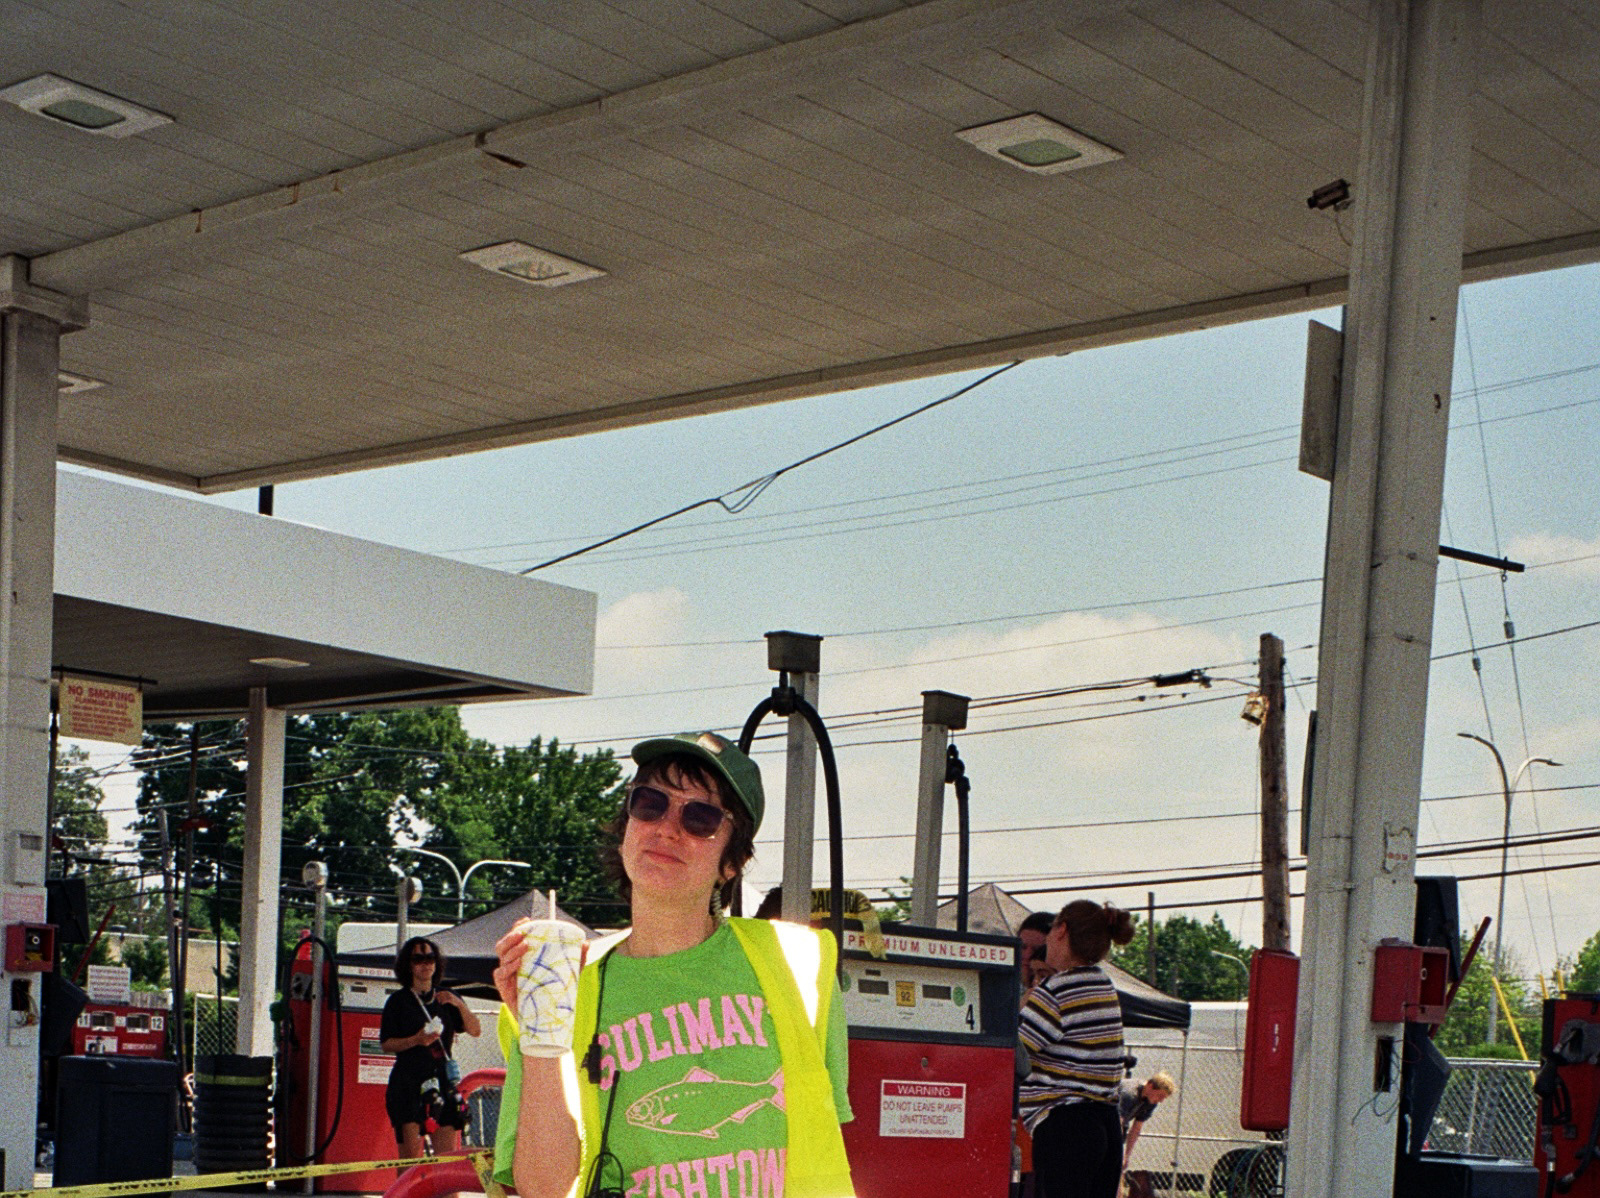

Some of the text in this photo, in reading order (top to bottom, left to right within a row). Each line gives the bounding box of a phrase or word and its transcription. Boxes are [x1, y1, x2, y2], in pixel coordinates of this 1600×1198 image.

[68, 685, 135, 703] NO SMOKING
[848, 934, 1008, 961] PRMIUM UNLEADED
[151, 1017, 163, 1030] 12
[965, 1003, 975, 1031] 4
[597, 994, 769, 1091] SULIMAY
[897, 1084, 951, 1097] WARNING
[883, 1100, 963, 1113] DO NOT LEAVE PUMPS
[899, 1114, 948, 1125] UNATTENDED
